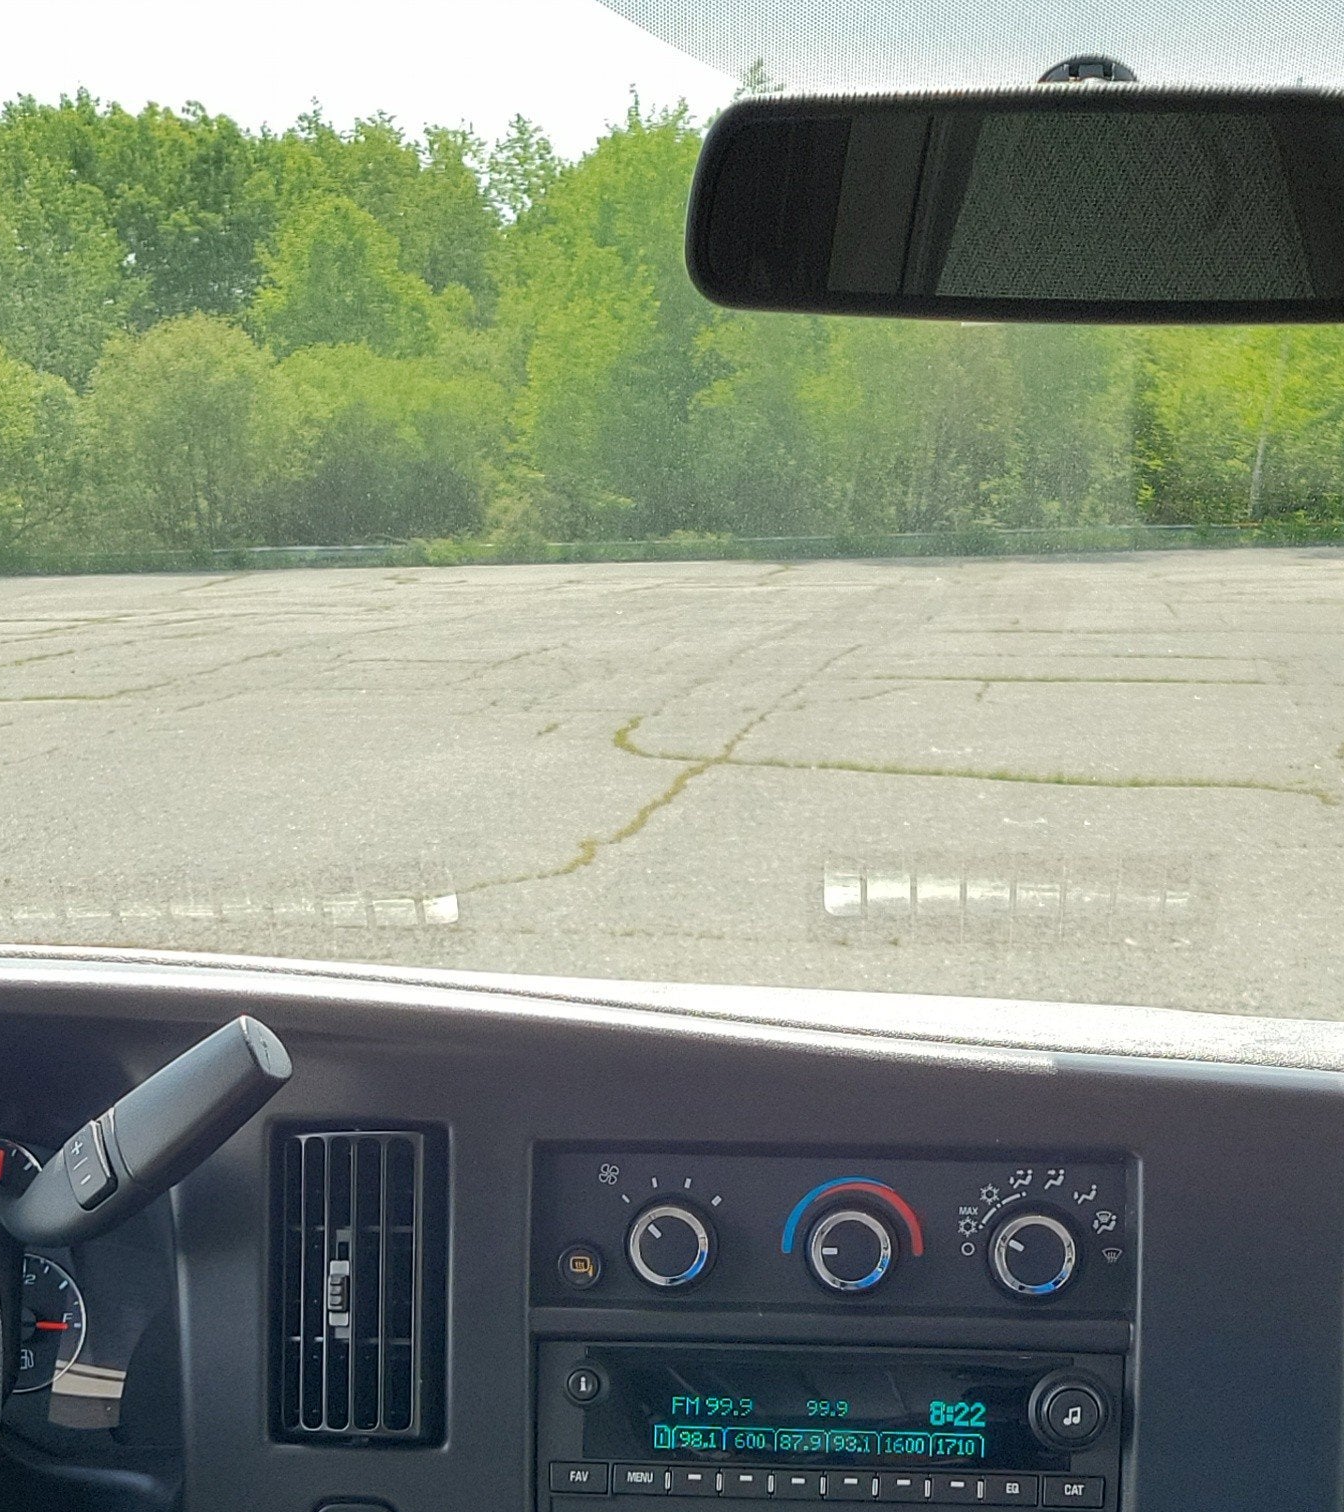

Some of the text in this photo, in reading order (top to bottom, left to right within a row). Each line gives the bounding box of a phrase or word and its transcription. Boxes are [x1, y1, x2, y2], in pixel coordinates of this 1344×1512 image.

[959, 1207, 978, 1215] MAX
[672, 1397, 753, 1416] FM 99.9
[807, 1400, 848, 1417] 99.9
[929, 1401, 986, 1427] 8:22
[679, 1432, 716, 1448] 98.1
[735, 1433, 766, 1449] 600
[780, 1435, 821, 1451] 87.9
[833, 1436, 870, 1453] 93.1
[885, 1437, 923, 1454] 1600
[937, 1439, 975, 1455] 1710
[570, 1471, 589, 1482] FAV
[627, 1471, 653, 1483] MENU
[1006, 1483, 1019, 1494] EQ
[1064, 1484, 1084, 1496] CAT
